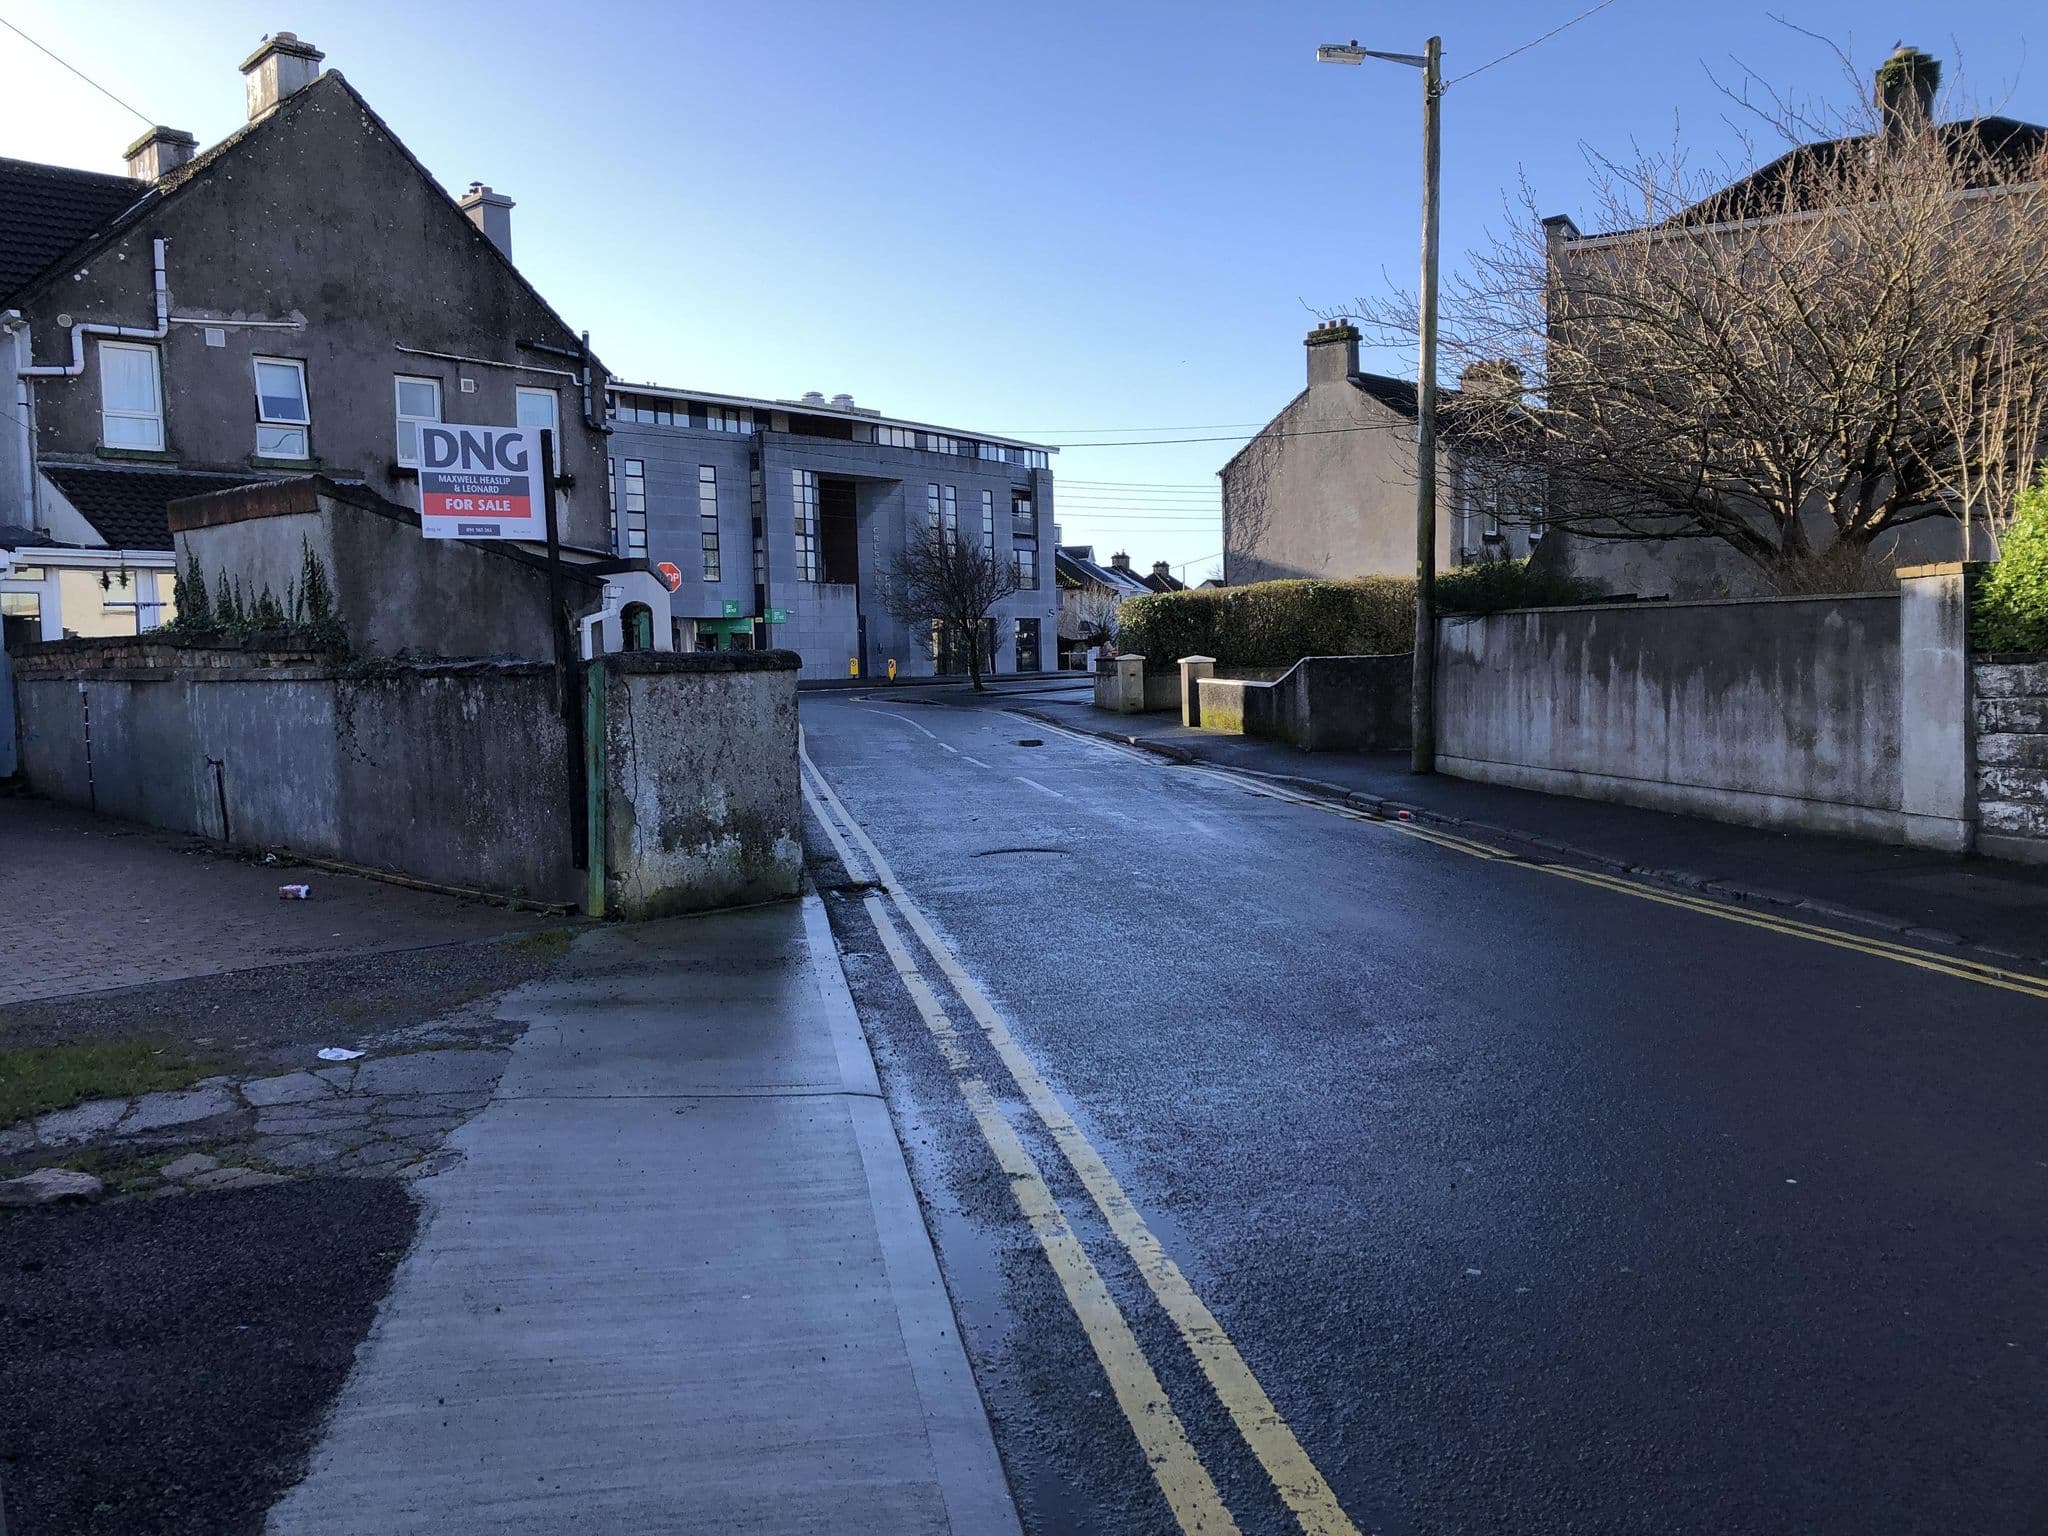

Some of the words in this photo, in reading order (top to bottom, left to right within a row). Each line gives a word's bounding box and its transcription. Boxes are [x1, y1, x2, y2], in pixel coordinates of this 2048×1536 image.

[423, 428, 529, 472] DNG
[438, 474, 477, 484] MAXWELL
[479, 476, 511, 485] HEASLIP
[454, 484, 460, 492] &
[462, 485, 500, 493] LEONARD
[445, 498, 474, 511] FOR
[477, 499, 511, 512] SALE
[666, 572, 679, 582] OP
